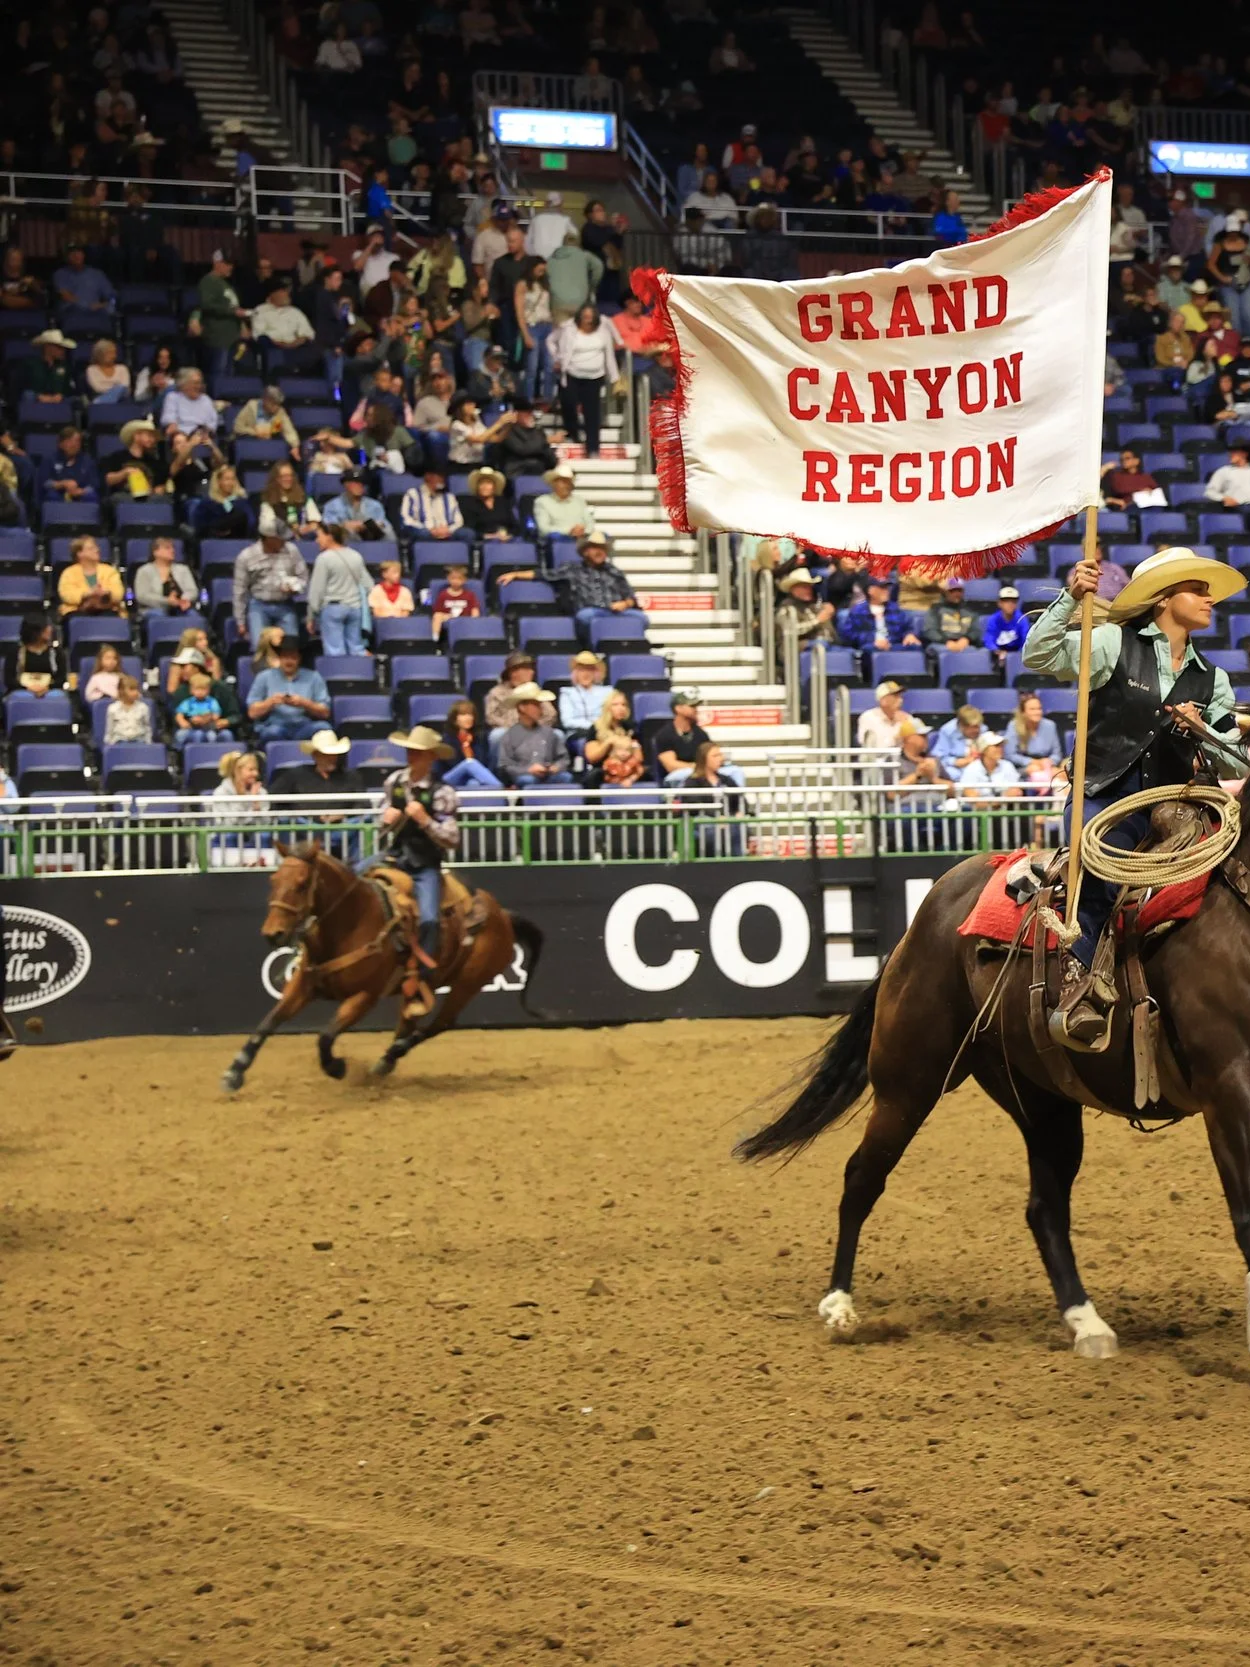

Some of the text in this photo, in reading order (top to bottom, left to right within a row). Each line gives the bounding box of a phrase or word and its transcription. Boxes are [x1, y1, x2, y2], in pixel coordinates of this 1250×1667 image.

[797, 275, 1008, 342] GRAND
[787, 351, 1023, 423] CANYON
[801, 436, 1018, 503] REGION
